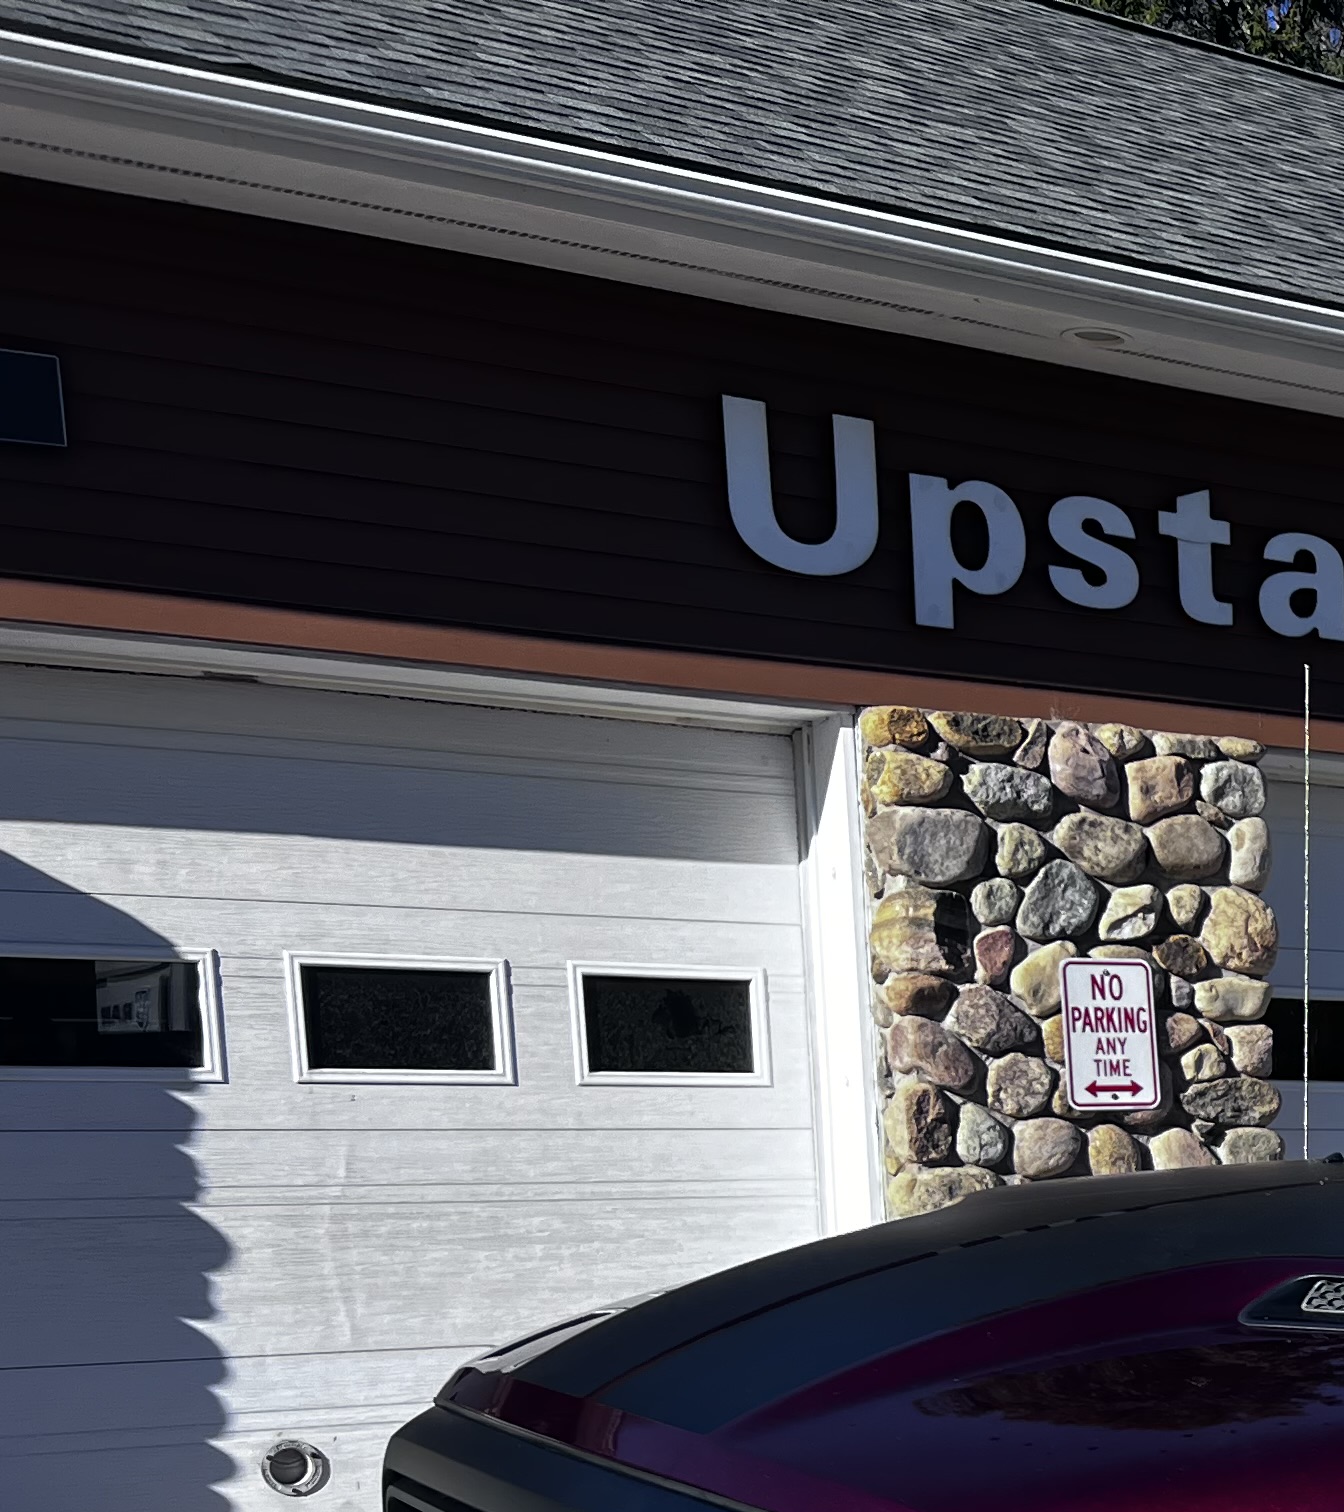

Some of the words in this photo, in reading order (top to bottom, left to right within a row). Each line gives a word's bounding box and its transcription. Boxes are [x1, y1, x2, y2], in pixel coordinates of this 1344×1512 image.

[1090, 974, 1123, 1001] NO
[1071, 1006, 1148, 1034] PARKING
[1095, 1037, 1127, 1055] ANY
[1093, 1058, 1132, 1077] TIME
